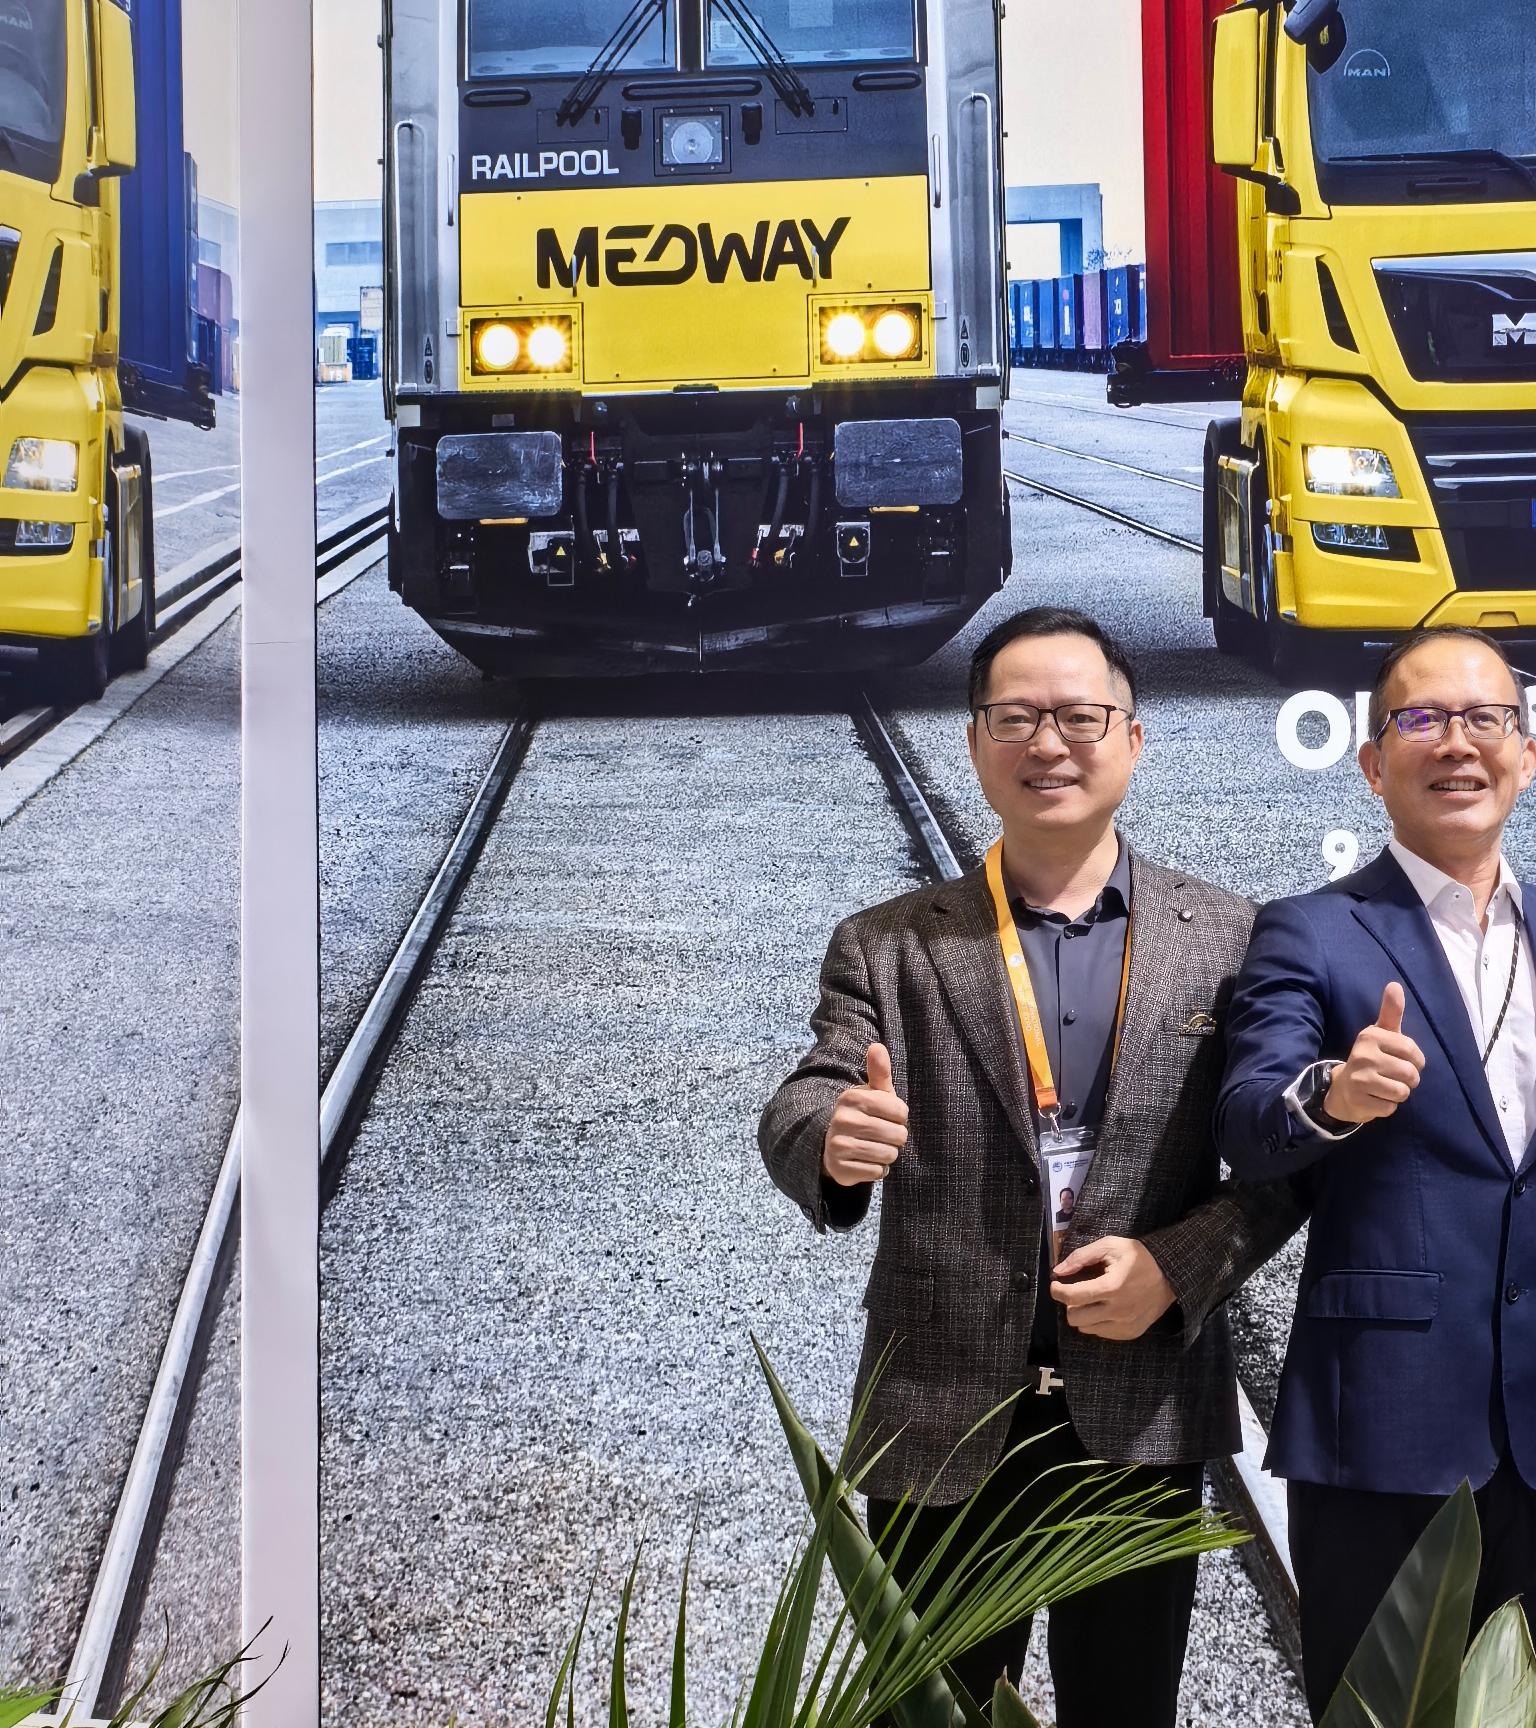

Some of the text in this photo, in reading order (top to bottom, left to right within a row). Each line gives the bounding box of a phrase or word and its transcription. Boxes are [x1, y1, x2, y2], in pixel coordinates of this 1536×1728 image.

[1347, 68, 1386, 77] MAN
[472, 150, 619, 180] RAILPOOL
[536, 217, 851, 289] MEDWAY
